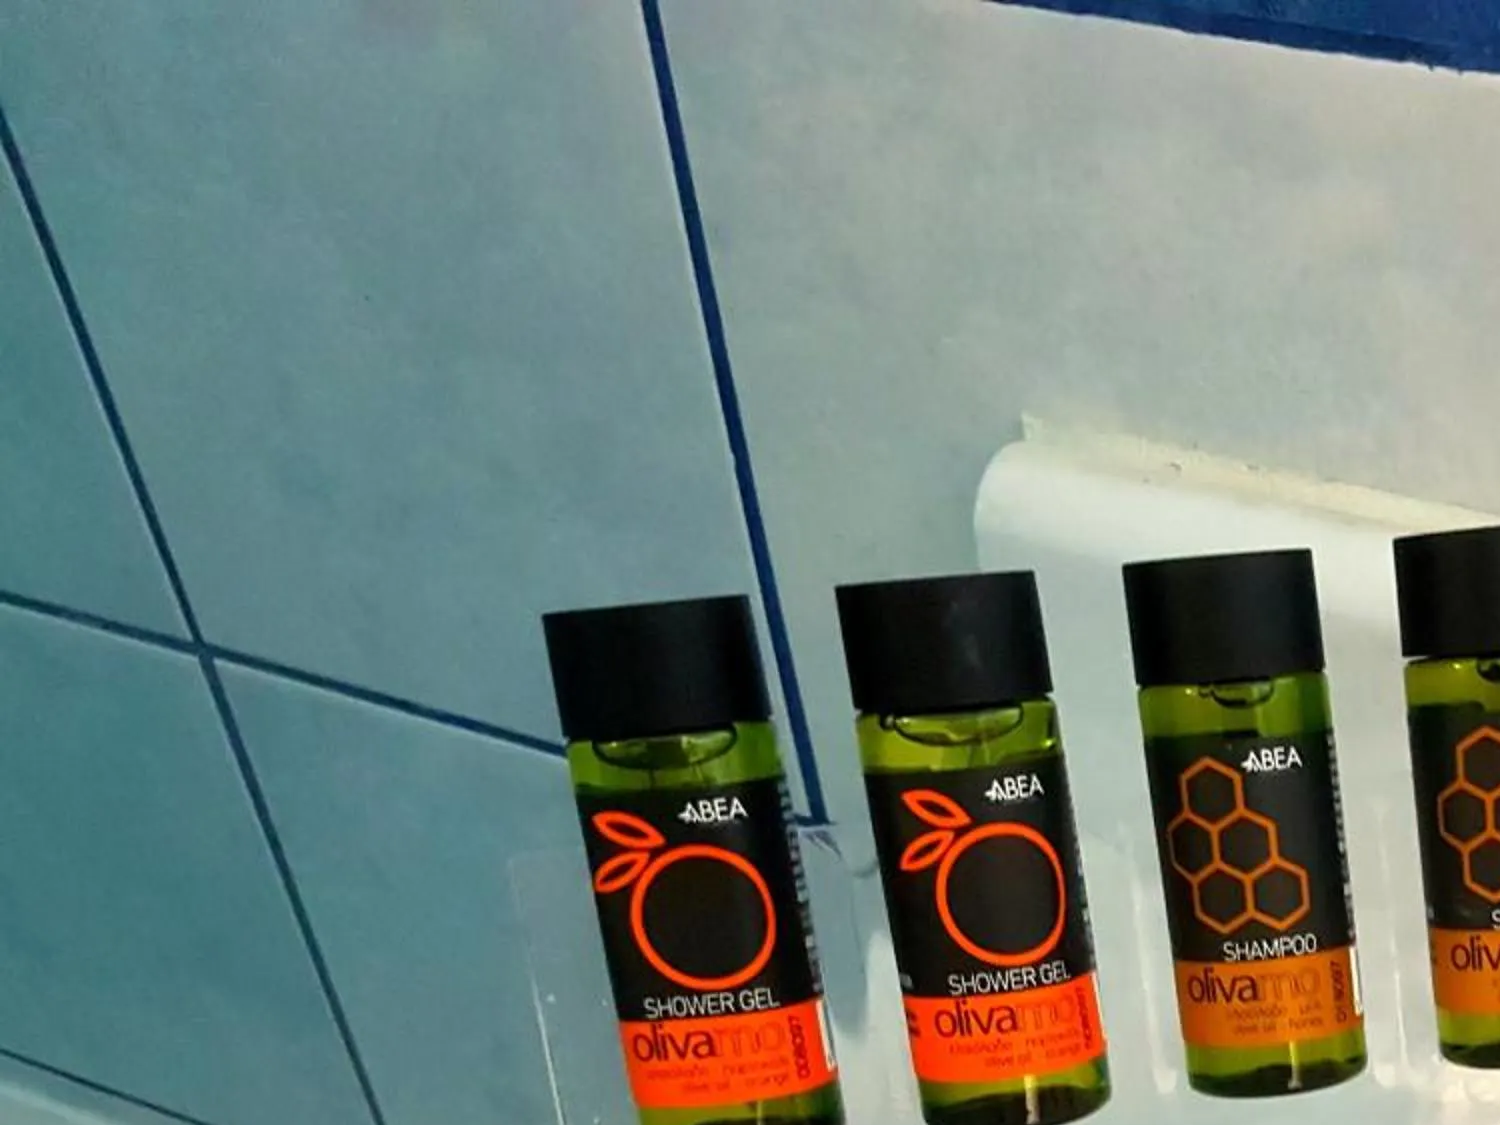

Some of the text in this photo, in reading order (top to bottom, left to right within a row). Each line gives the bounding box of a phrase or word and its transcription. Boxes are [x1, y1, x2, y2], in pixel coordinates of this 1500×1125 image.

[1240, 745, 1303, 772] ABEA
[984, 773, 1045, 802] ABEA
[676, 796, 749, 825] ABEA
[1222, 933, 1318, 962] SHAMPOO
[948, 961, 1071, 996] SHOWER GEL
[643, 987, 781, 1019] SHOWER GEL
